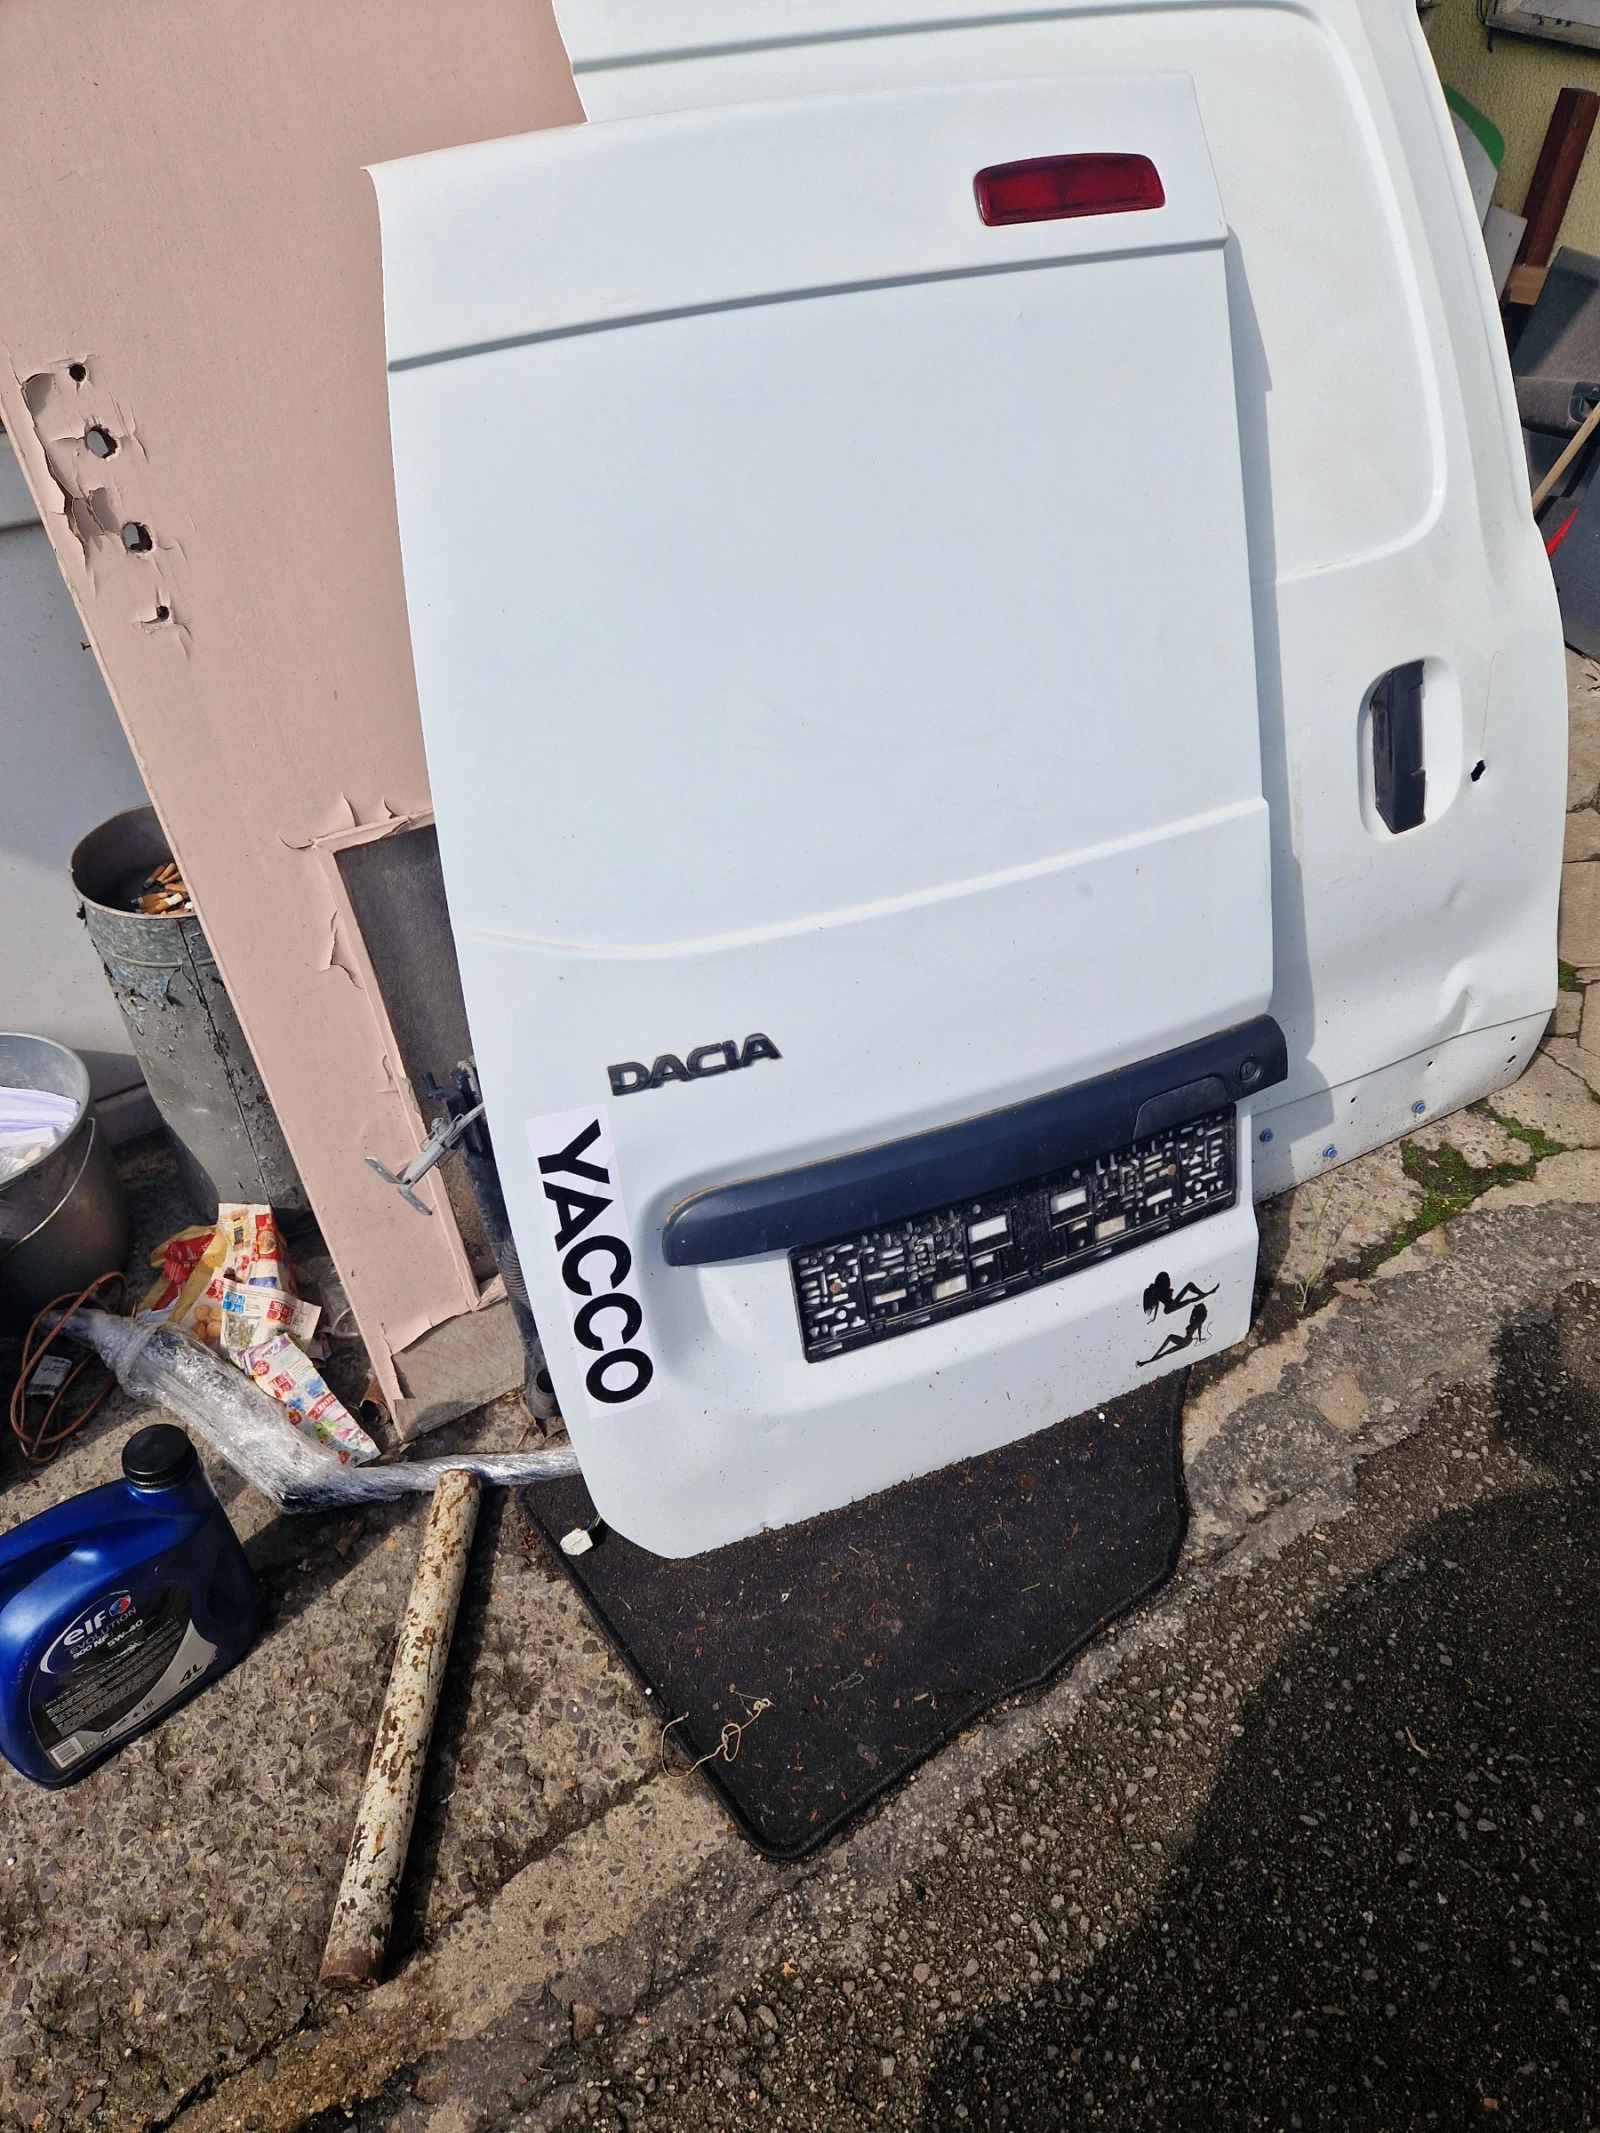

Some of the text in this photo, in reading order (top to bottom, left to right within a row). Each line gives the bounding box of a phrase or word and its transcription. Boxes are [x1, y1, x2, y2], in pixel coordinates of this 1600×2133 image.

[607, 1033, 783, 1096] DACIA
[537, 1118, 654, 1404] YACCO
[63, 1610, 107, 1646] elf
[69, 1606, 137, 1655] EVOLUTION
[106, 1619, 144, 1648] 5W-40
[72, 1633, 110, 1660] 900 NF
[179, 1663, 203, 1684] 4L
